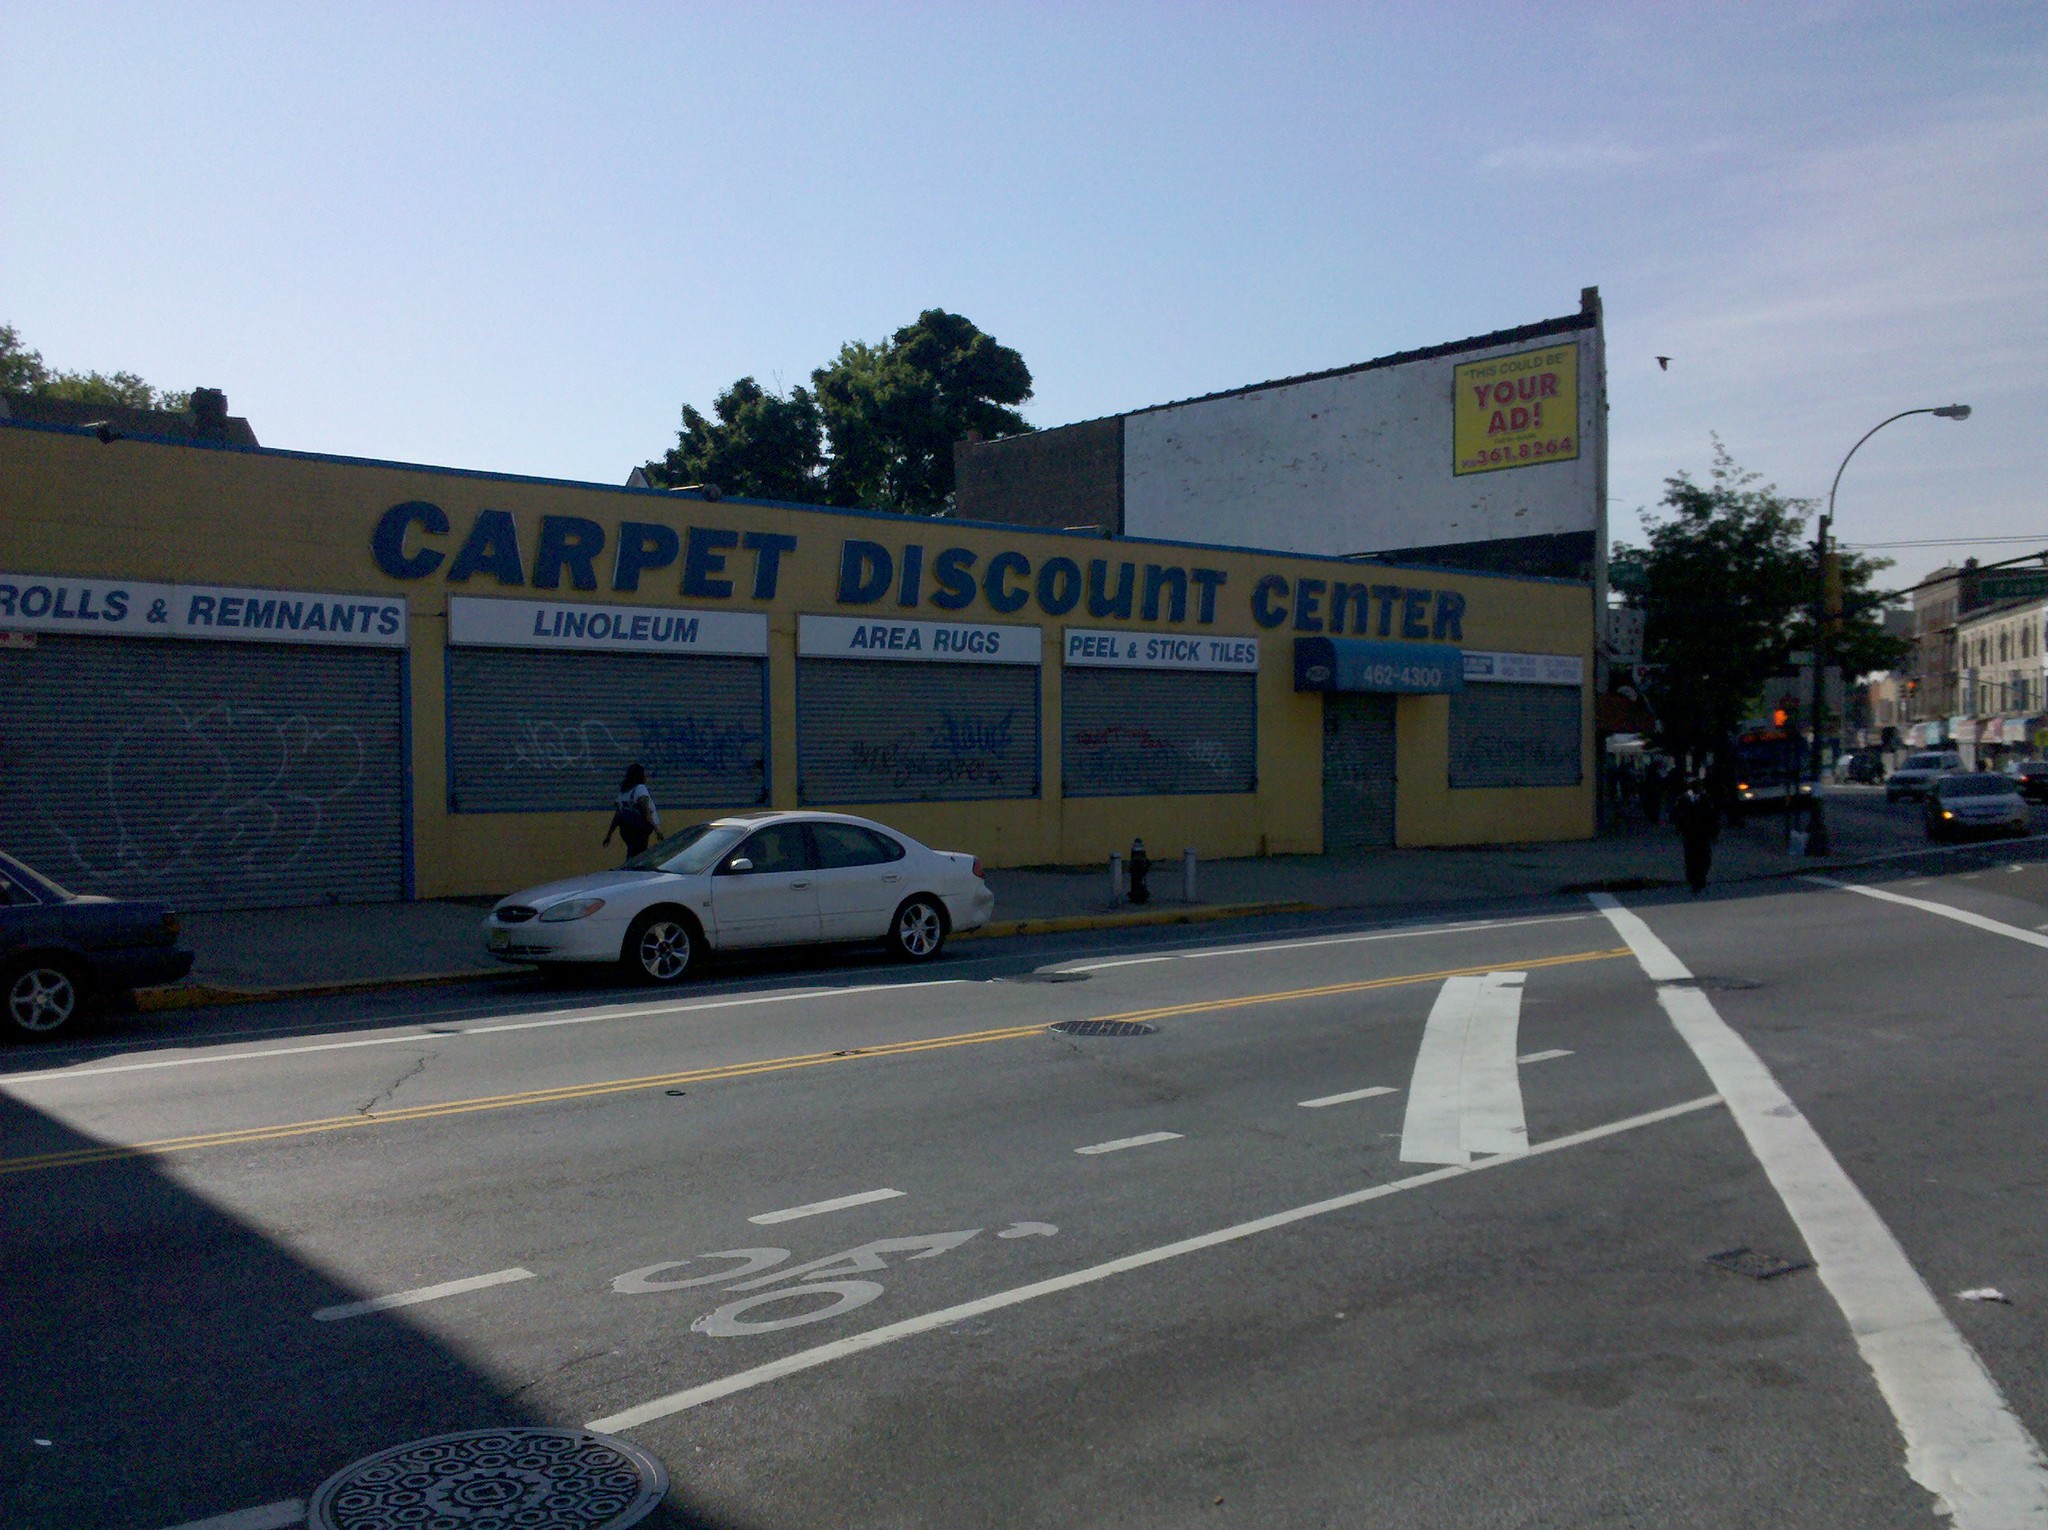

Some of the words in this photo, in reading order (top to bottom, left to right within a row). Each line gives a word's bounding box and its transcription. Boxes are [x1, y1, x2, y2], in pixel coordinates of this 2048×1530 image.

[1474, 372, 1558, 408] YOUR
[1487, 401, 1541, 434] AD!
[370, 501, 797, 600] CARPET
[147, 598, 168, 623] &
[187, 595, 400, 635] REMNANTS
[533, 610, 698, 643] LINOLEUM
[850, 625, 921, 650] AREA
[933, 629, 1000, 654] RUGS
[1069, 635, 1119, 659] PEEL
[1127, 643, 1137, 658] &
[1147, 641, 1200, 661] STICK
[1210, 643, 1256, 664] TILES
[1363, 664, 1442, 687] 462-4300
